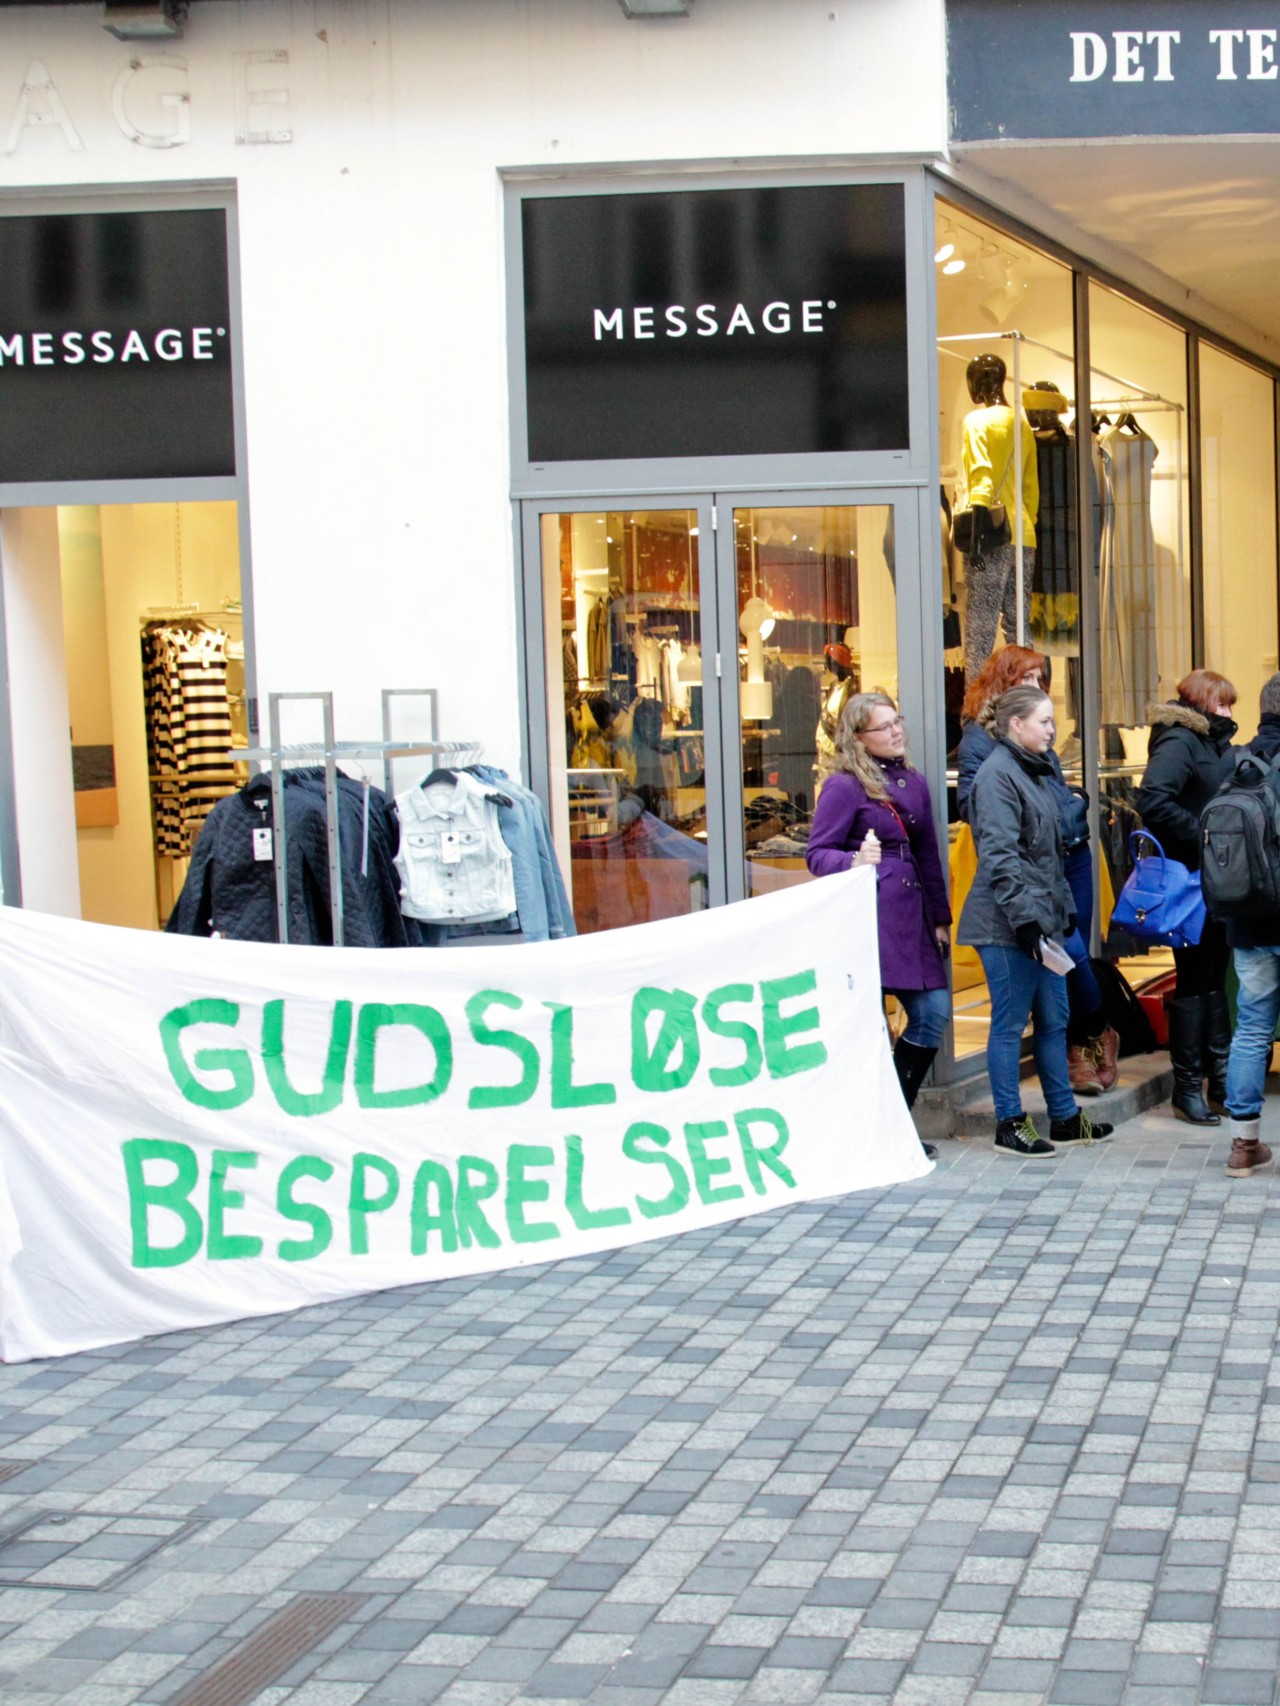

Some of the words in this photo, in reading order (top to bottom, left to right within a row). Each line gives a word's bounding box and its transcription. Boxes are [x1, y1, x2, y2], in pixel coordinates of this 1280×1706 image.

[1069, 31, 1181, 83] DET
[594, 301, 824, 341] MESSAGE
[159, 970, 828, 1116] GUDSLØSE
[122, 1107, 798, 1268] BESPARELSER
